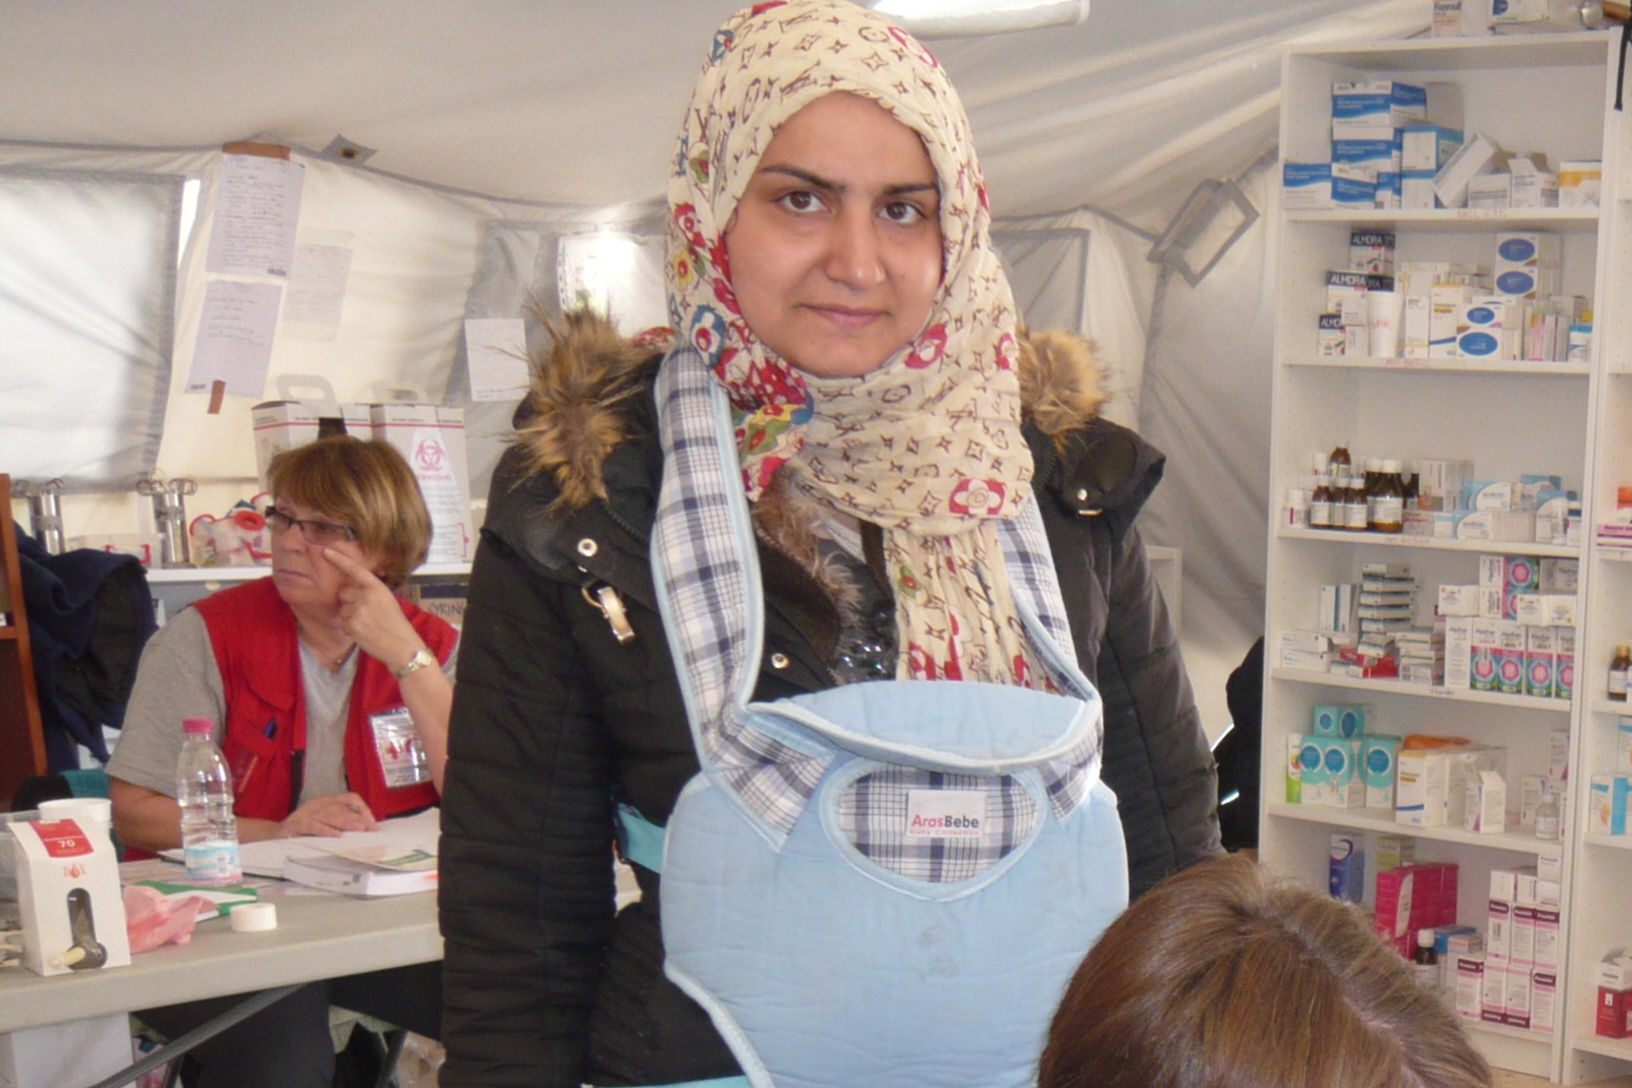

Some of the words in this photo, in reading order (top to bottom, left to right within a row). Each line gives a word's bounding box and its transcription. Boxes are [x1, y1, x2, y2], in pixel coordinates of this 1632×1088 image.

[1352, 235, 1383, 245] ALMORA
[1330, 274, 1366, 287] ALMORA
[1321, 318, 1341, 328] ALMO
[911, 814, 979, 828] ArasBebe
[58, 839, 76, 848] 70
